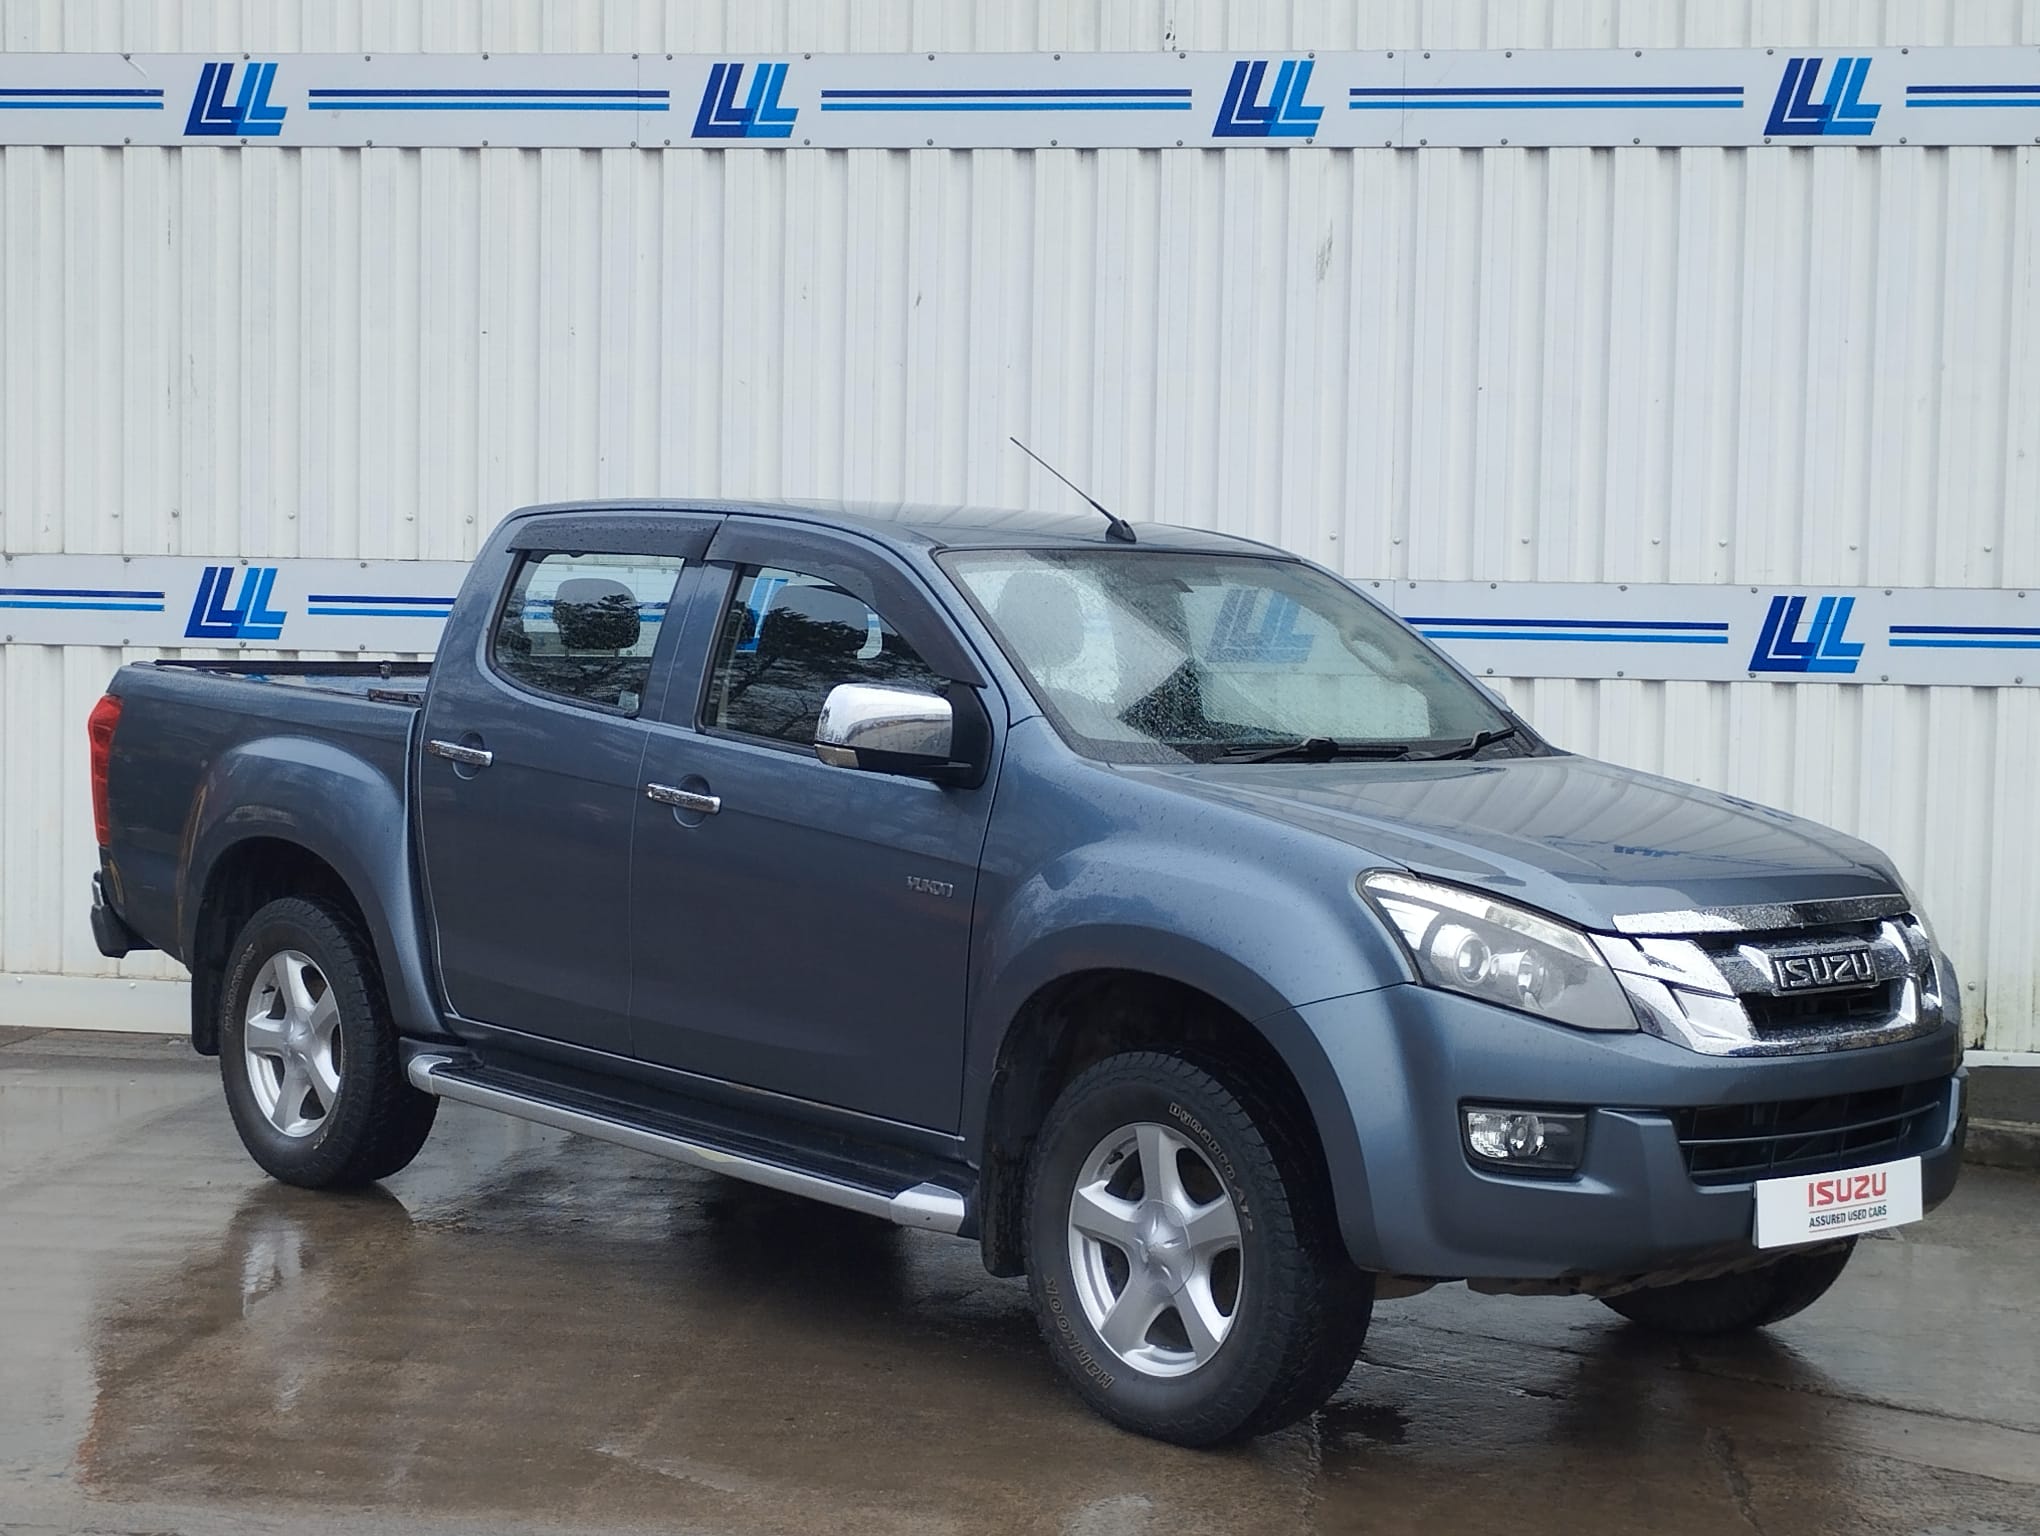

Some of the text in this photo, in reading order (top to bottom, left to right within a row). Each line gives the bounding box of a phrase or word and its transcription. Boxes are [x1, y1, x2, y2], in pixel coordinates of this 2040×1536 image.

[1774, 952, 1874, 988] ISUZU
[1807, 1171, 1887, 1208] ISUZU
[1808, 1204, 1888, 1229] ASSURED USED CARS
